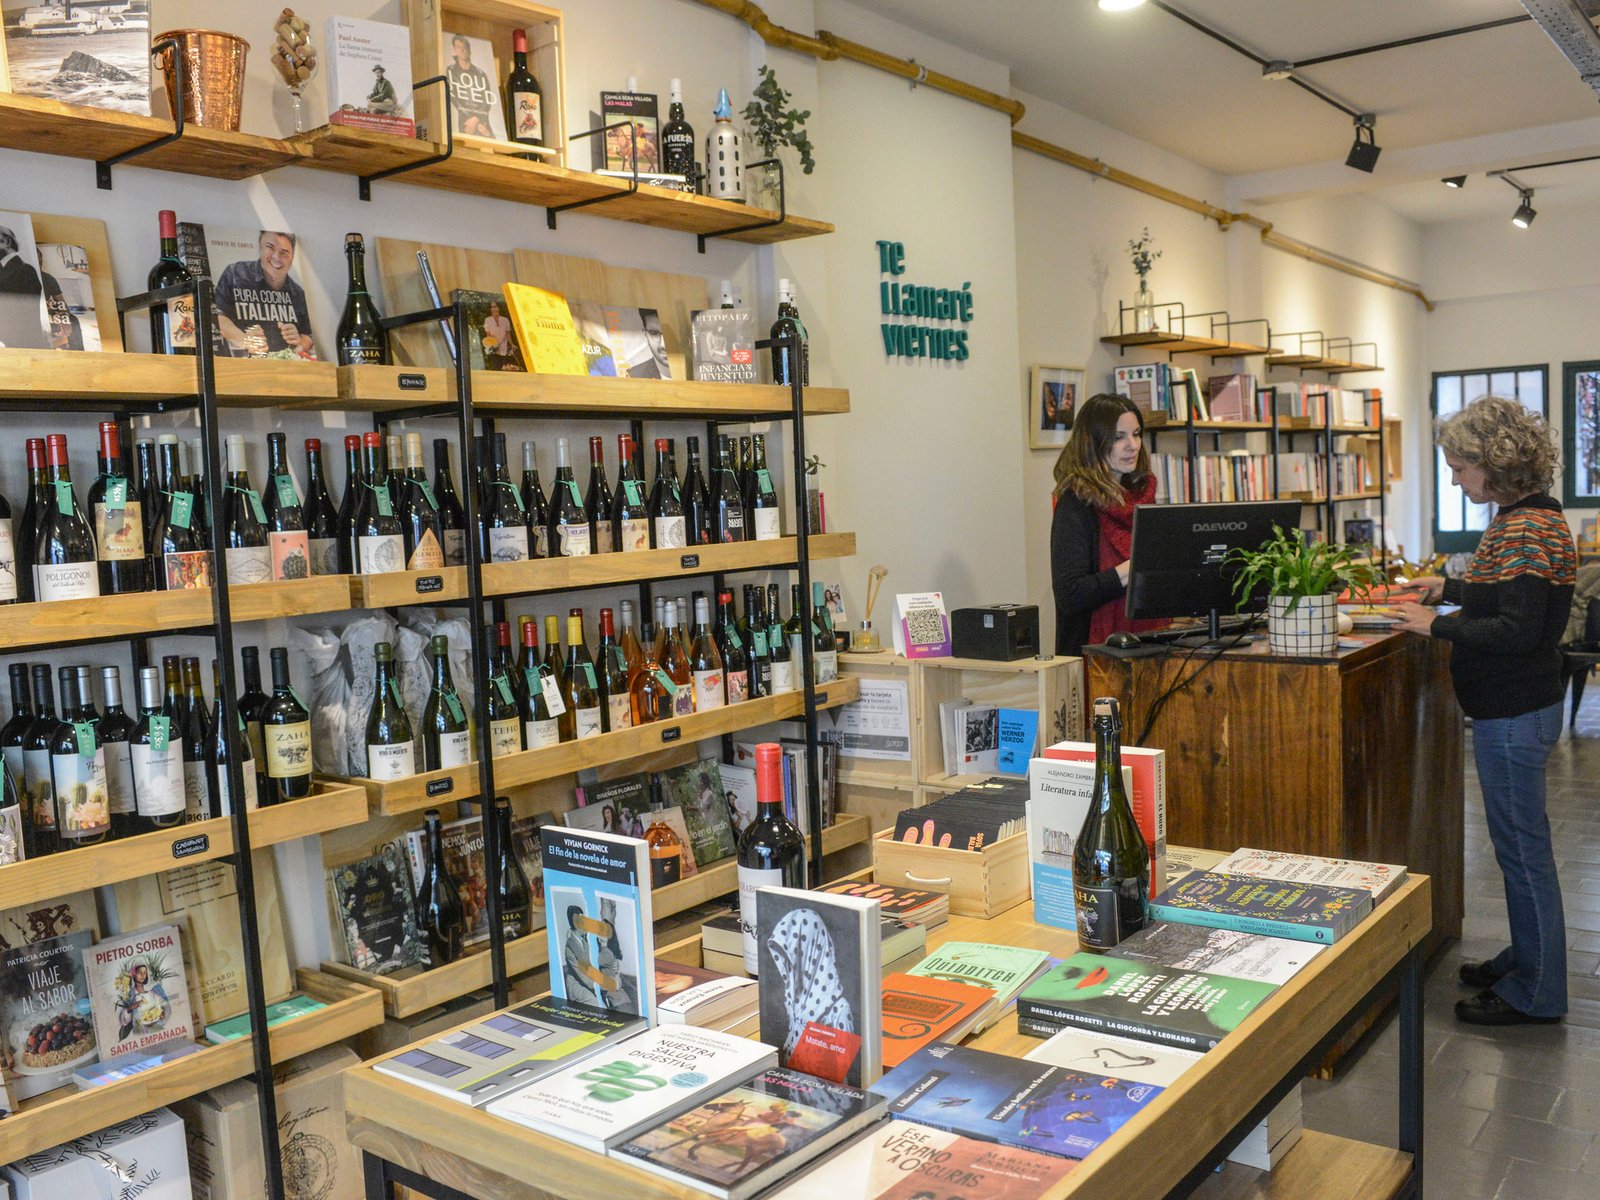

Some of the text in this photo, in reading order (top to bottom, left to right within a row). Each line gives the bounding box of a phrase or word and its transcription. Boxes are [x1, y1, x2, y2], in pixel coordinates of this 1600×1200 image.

[353, 36, 370, 44] Auster
[347, 51, 366, 60] Stephen
[362, 46, 383, 54] inmortal
[448, 70, 486, 91] LOU
[876, 240, 905, 275] Te
[234, 288, 292, 305] PURA COCINA
[235, 302, 298, 322] ITALIANA
[536, 320, 565, 331] Emma
[350, 350, 380, 358] ZAHA
[700, 364, 745, 373] INFANCIA
[700, 371, 753, 380] JUVENTUD
[1192, 522, 1248, 532] DAEWOO
[276, 731, 309, 741] ZAHA
[1048, 770, 1074, 779] ALEJANDRO
[596, 787, 618, 800] DISEÑOS
[618, 783, 642, 795] FLORALES
[1040, 783, 1094, 799] Literatura infa
[442, 834, 466, 848] NEMOS
[459, 837, 484, 857] JUNTOS
[564, 838, 608, 854] VIVIAN GORNICK
[549, 845, 555, 855] El
[555, 846, 564, 856] fin
[564, 849, 572, 858] de
[573, 850, 579, 860] la
[580, 852, 600, 864] novela
[600, 856, 609, 865] de
[610, 859, 626, 868] amor
[1074, 889, 1099, 904] AHA
[7, 944, 74, 967] PATRICIA COURTOIS
[95, 935, 174, 965] PIETRO SORBA
[27, 965, 62, 990] VIAJE
[924, 957, 1018, 982] QUIDDITCH
[1102, 972, 1139, 996] DANIEL
[1118, 975, 1150, 997] LÓPEZ
[1127, 975, 1168, 1004] ROSETTI
[22, 983, 77, 1016] AL SABOR
[1142, 974, 1197, 1015] LA GIOCONDA
[1157, 976, 1209, 1017] Y LEONARDO
[559, 1011, 583, 1019] singular
[581, 1011, 608, 1019] GORNICK
[1031, 1006, 1053, 1016] DANIEL
[1054, 1008, 1074, 1020] LÓPEZ
[1075, 1015, 1103, 1026] ROSETTI
[1117, 1023, 1152, 1035] GIOCONDA
[1158, 1031, 1196, 1044] LEONARDO
[1032, 1024, 1054, 1034] DANIEL
[110, 1026, 188, 1056] SANTA EMPANADA
[657, 1040, 716, 1058] NUESTRA
[805, 1035, 846, 1054] Matate, amor
[628, 1050, 697, 1071] DIGESTIVA
[652, 1047, 697, 1061] SALUD
[766, 1070, 864, 1100] CAMILA SOSA VILLADA
[778, 1080, 814, 1093] MALAS
[901, 1127, 932, 1143] ESE
[881, 1136, 953, 1163] VERANO
[887, 1154, 985, 1188] A OSCURAS
